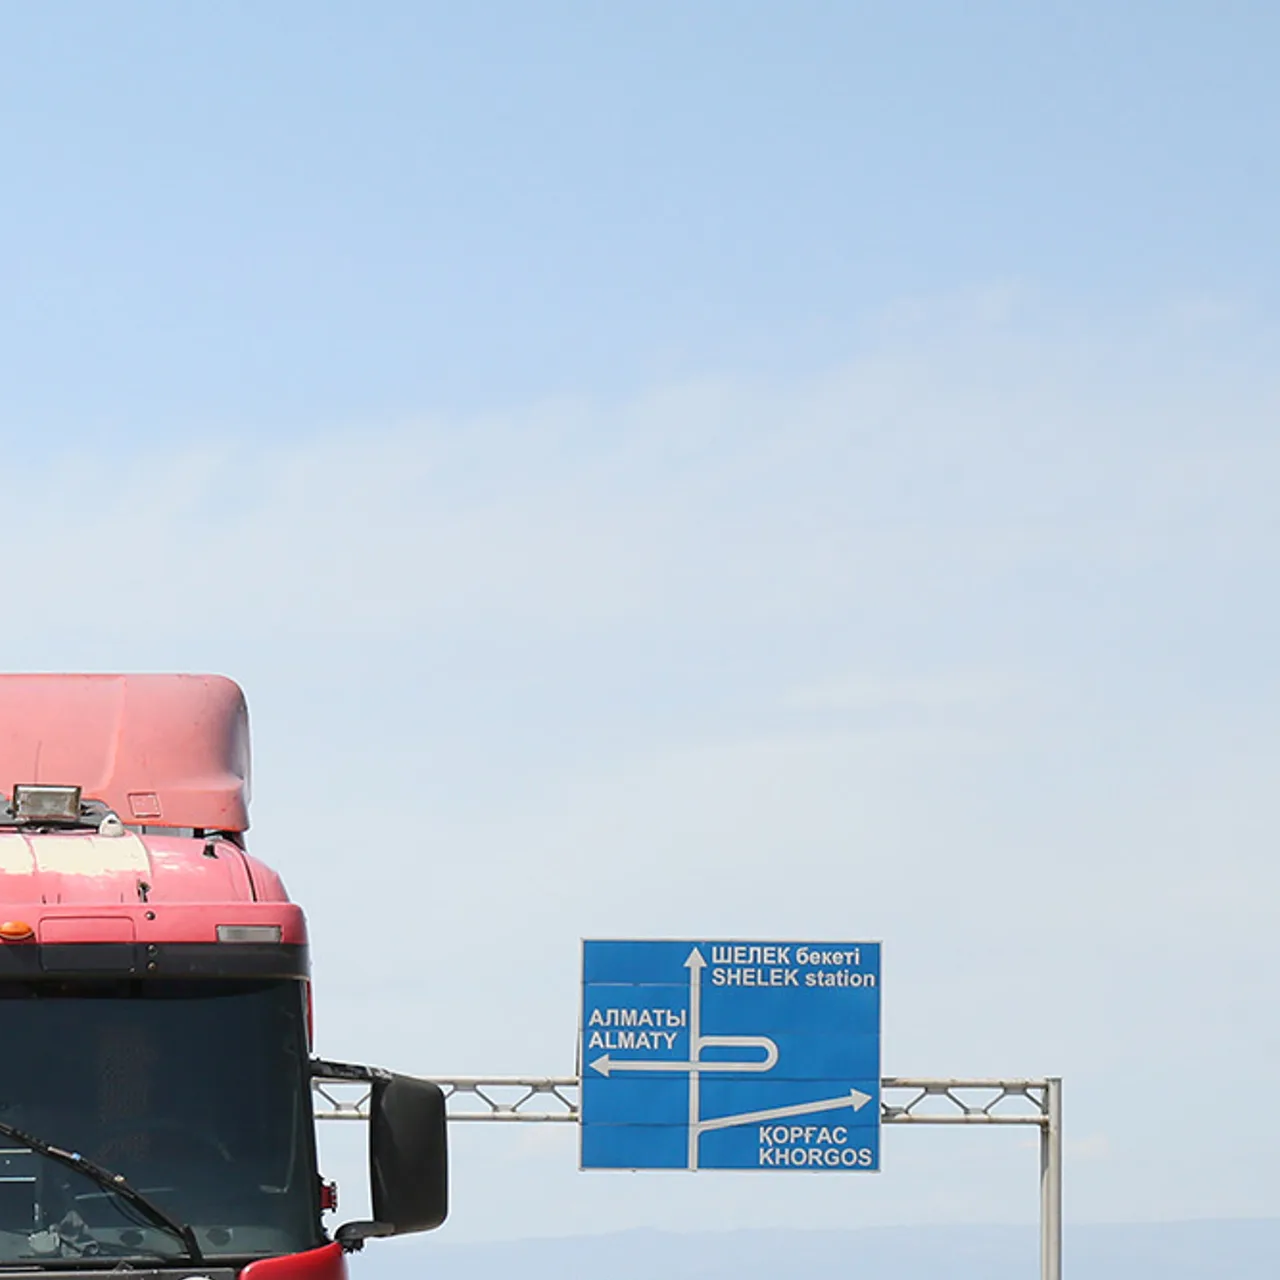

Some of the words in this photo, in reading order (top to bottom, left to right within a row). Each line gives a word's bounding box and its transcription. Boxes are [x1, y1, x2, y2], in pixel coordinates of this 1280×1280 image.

[711, 946, 791, 965] ШЕЛЕК
[796, 947, 860, 965] бекеті
[711, 968, 800, 986] SHELEK
[804, 969, 876, 987] station
[588, 1008, 687, 1027] АЛМАТЫ
[588, 1031, 678, 1050] ALMATY
[759, 1126, 848, 1146] ҚОРҒАС
[759, 1147, 873, 1167] KHORGOS
